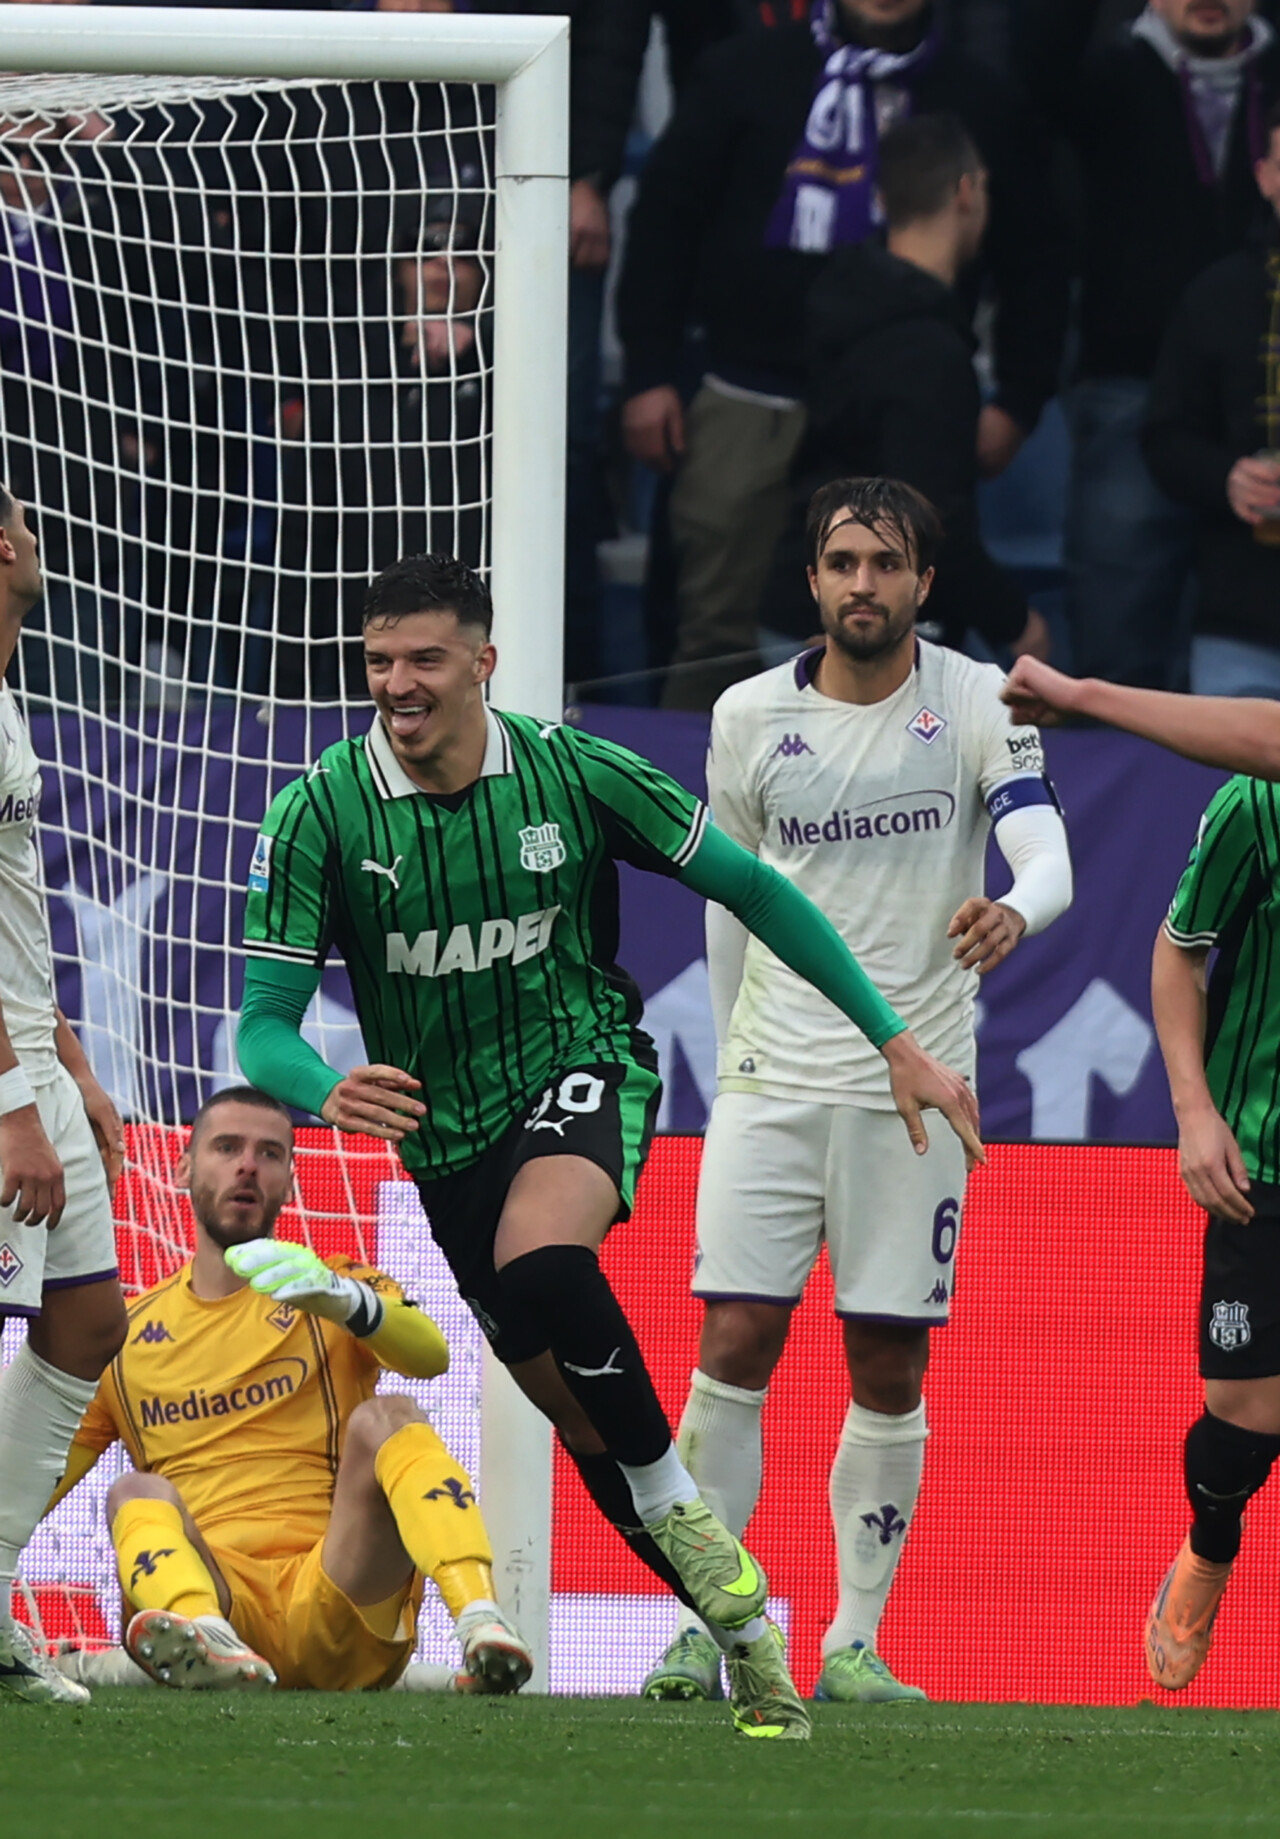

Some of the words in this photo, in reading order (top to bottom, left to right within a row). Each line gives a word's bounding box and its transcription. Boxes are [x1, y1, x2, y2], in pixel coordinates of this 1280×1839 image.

[778, 807, 941, 845] Mediacom
[386, 904, 562, 978] MAPEI
[931, 1196, 959, 1265] 6
[140, 1374, 294, 1428] Mediacom
